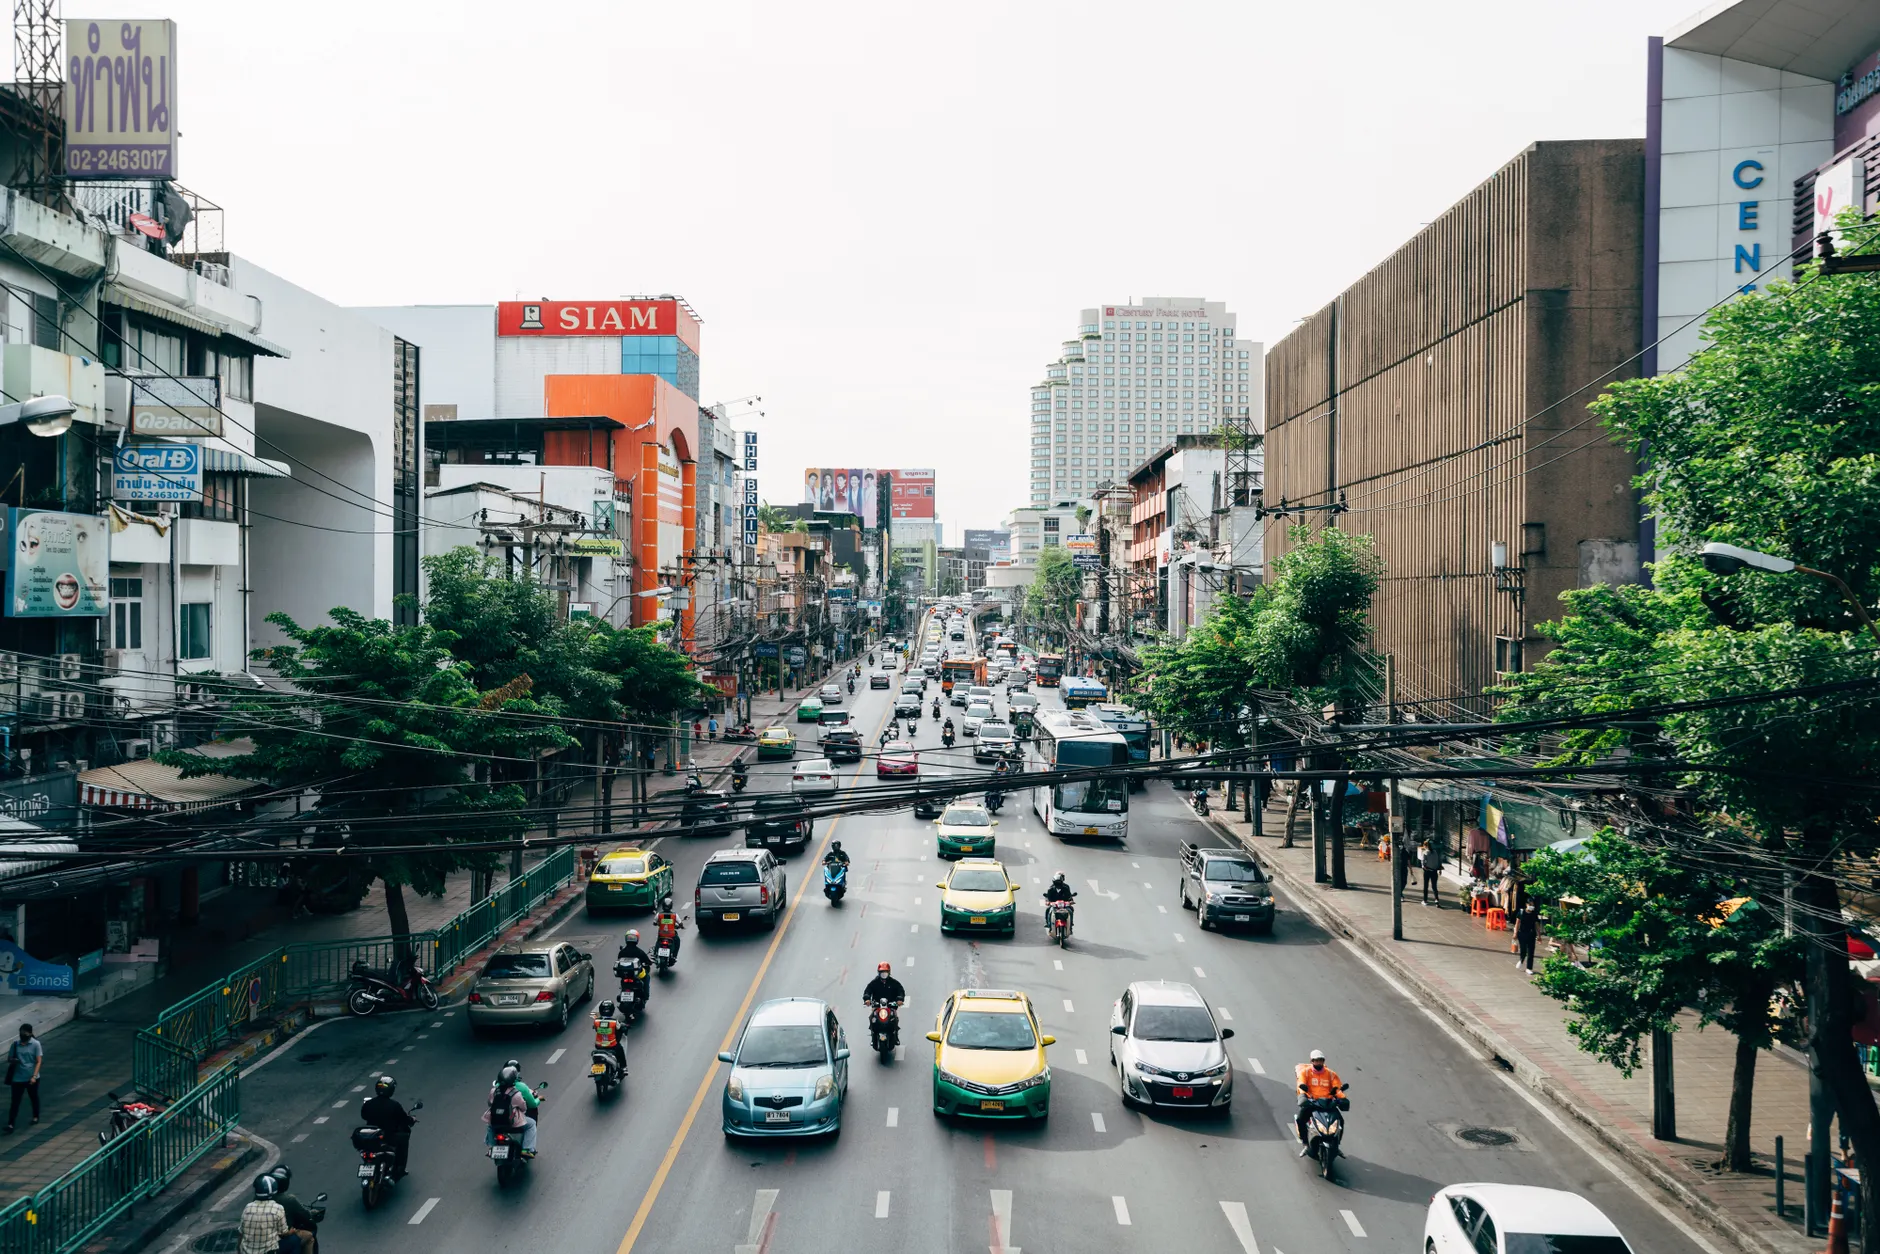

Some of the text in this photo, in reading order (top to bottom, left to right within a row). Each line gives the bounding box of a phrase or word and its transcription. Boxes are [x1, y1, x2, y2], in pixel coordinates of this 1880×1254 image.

[70, 22, 169, 133] ทำฟัน
[70, 149, 168, 171] 02-2463017
[559, 306, 658, 330] SIAM
[122, 449, 188, 468] Oral-B
[747, 433, 756, 470] THE
[131, 491, 192, 499] 02-2463017
[747, 480, 757, 543] BRAIN
